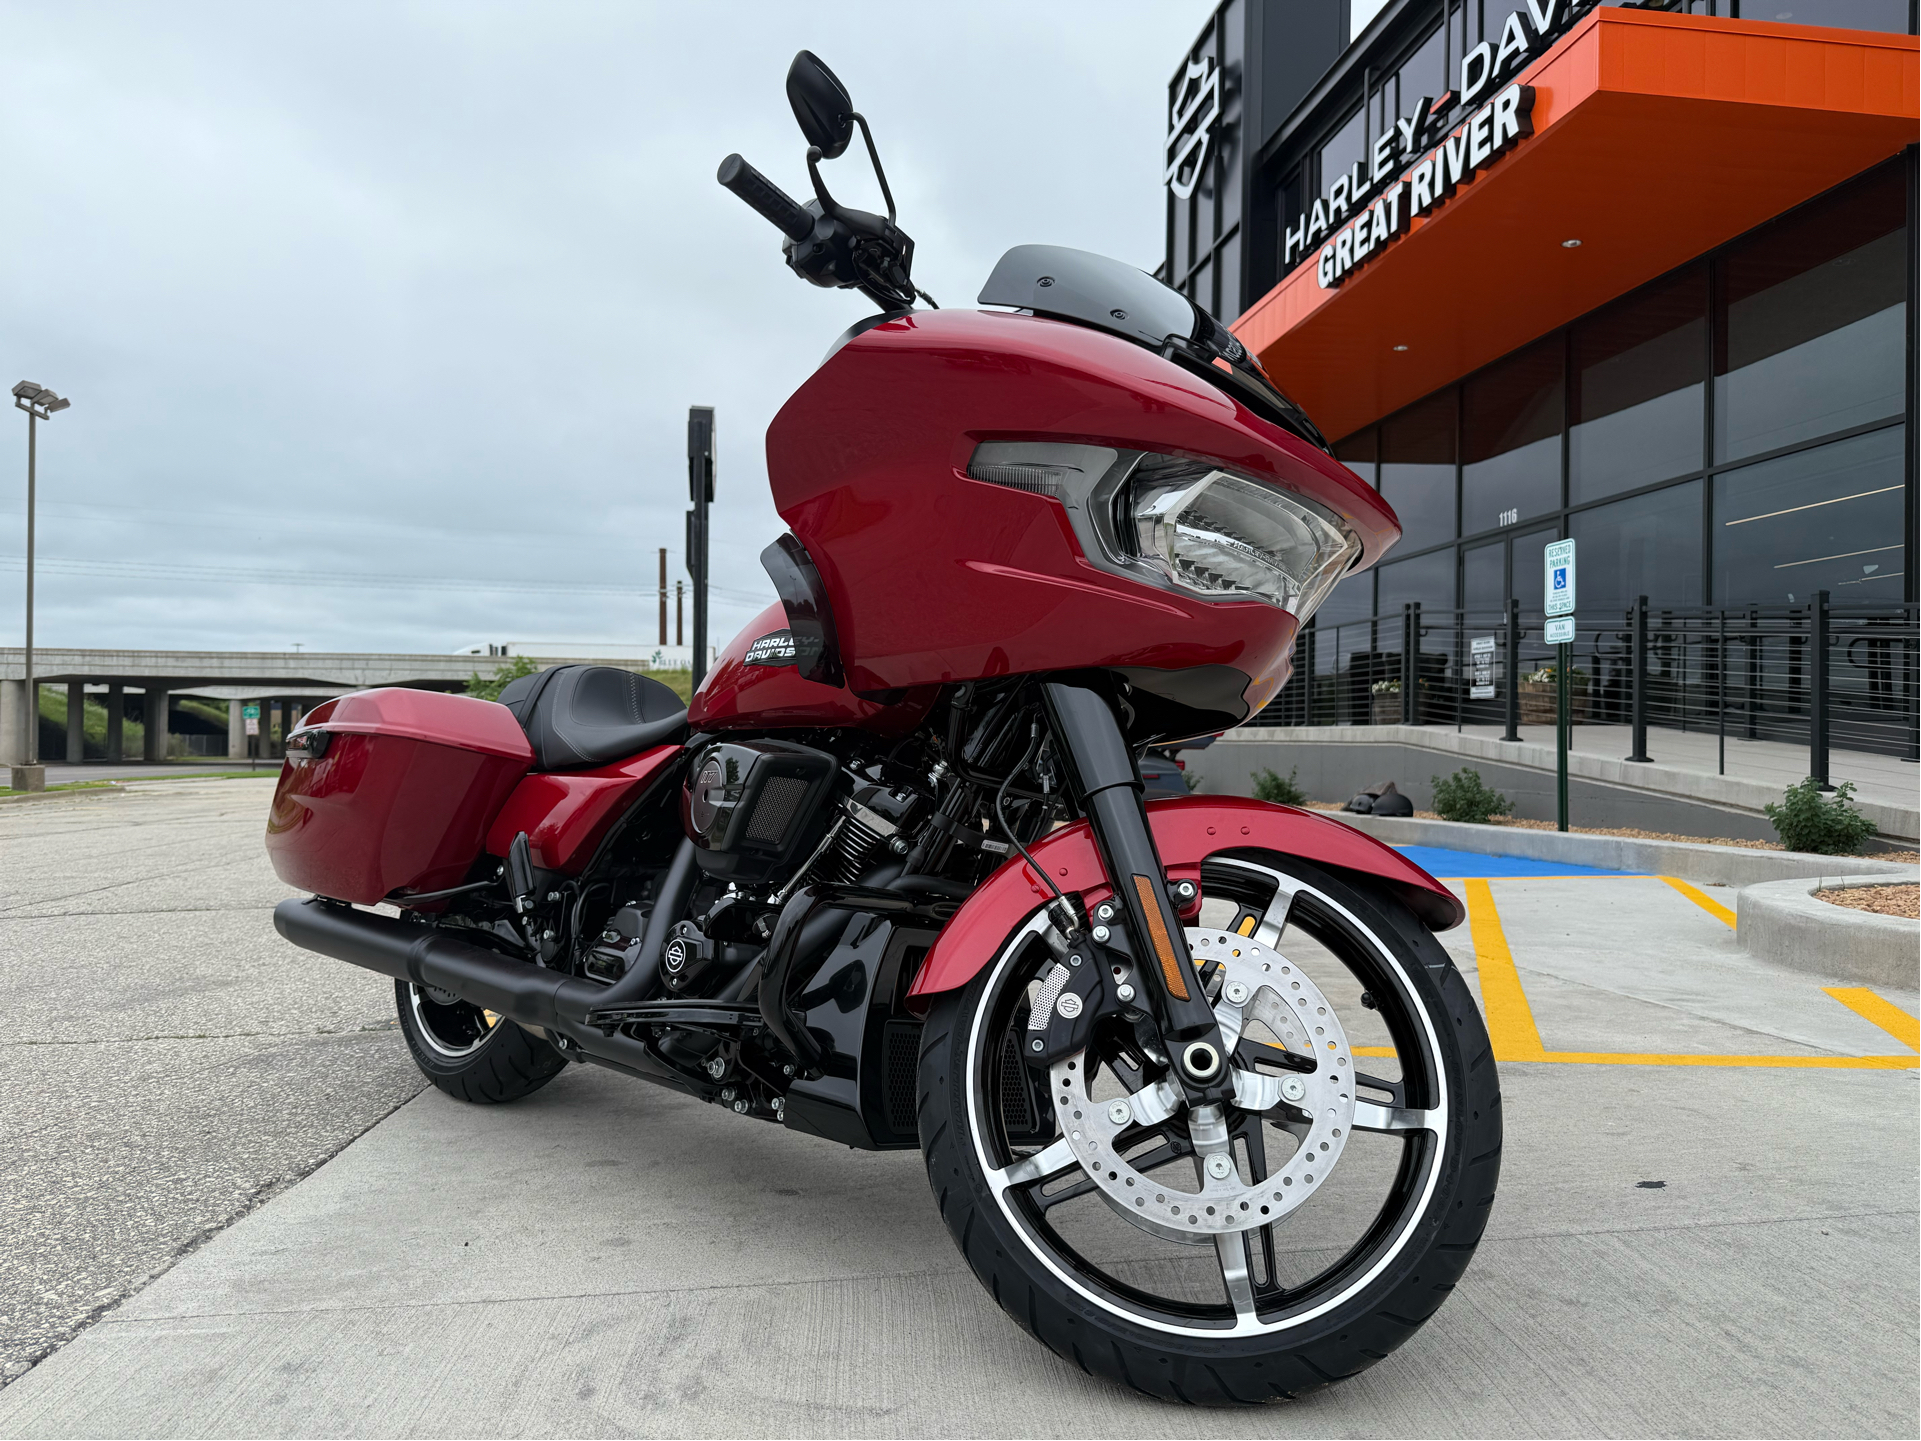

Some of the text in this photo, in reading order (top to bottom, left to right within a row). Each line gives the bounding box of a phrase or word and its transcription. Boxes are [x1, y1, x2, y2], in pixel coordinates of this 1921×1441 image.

[1284, 0, 1594, 264] HARLEY-DAV
[1317, 84, 1522, 289] GREAT RIVER
[1499, 508, 1518, 527] 1116
[1548, 544, 1571, 558] RESERVED
[1549, 555, 1570, 569] PARKING
[1548, 601, 1571, 611] THIS SPACE
